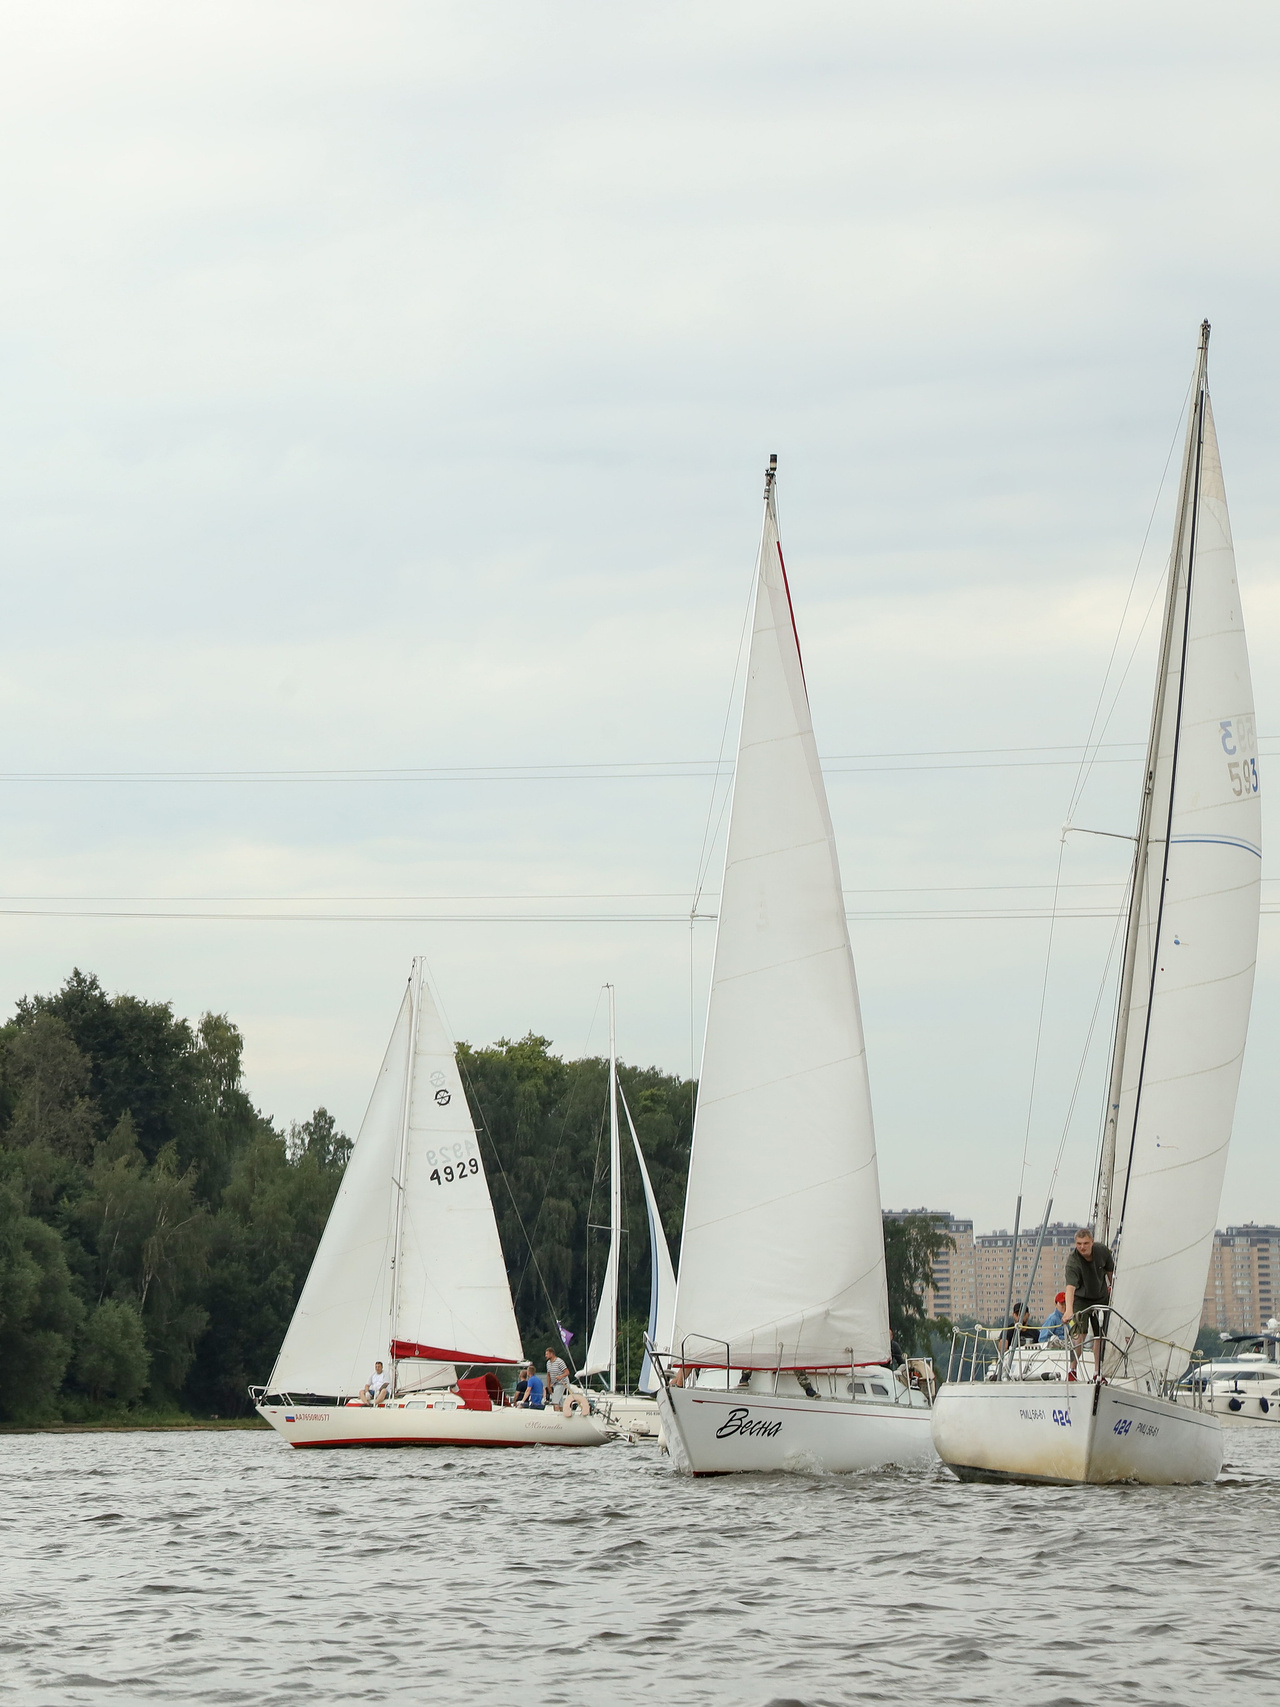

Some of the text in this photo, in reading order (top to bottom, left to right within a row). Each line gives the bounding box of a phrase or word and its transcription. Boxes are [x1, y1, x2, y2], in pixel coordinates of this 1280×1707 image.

[1228, 758, 1258, 796] 593
[430, 1158, 479, 1185] 4929
[716, 1408, 783, 1439] Весна
[1052, 1409, 1072, 1427] 424
[1112, 1419, 1133, 1437] 424
